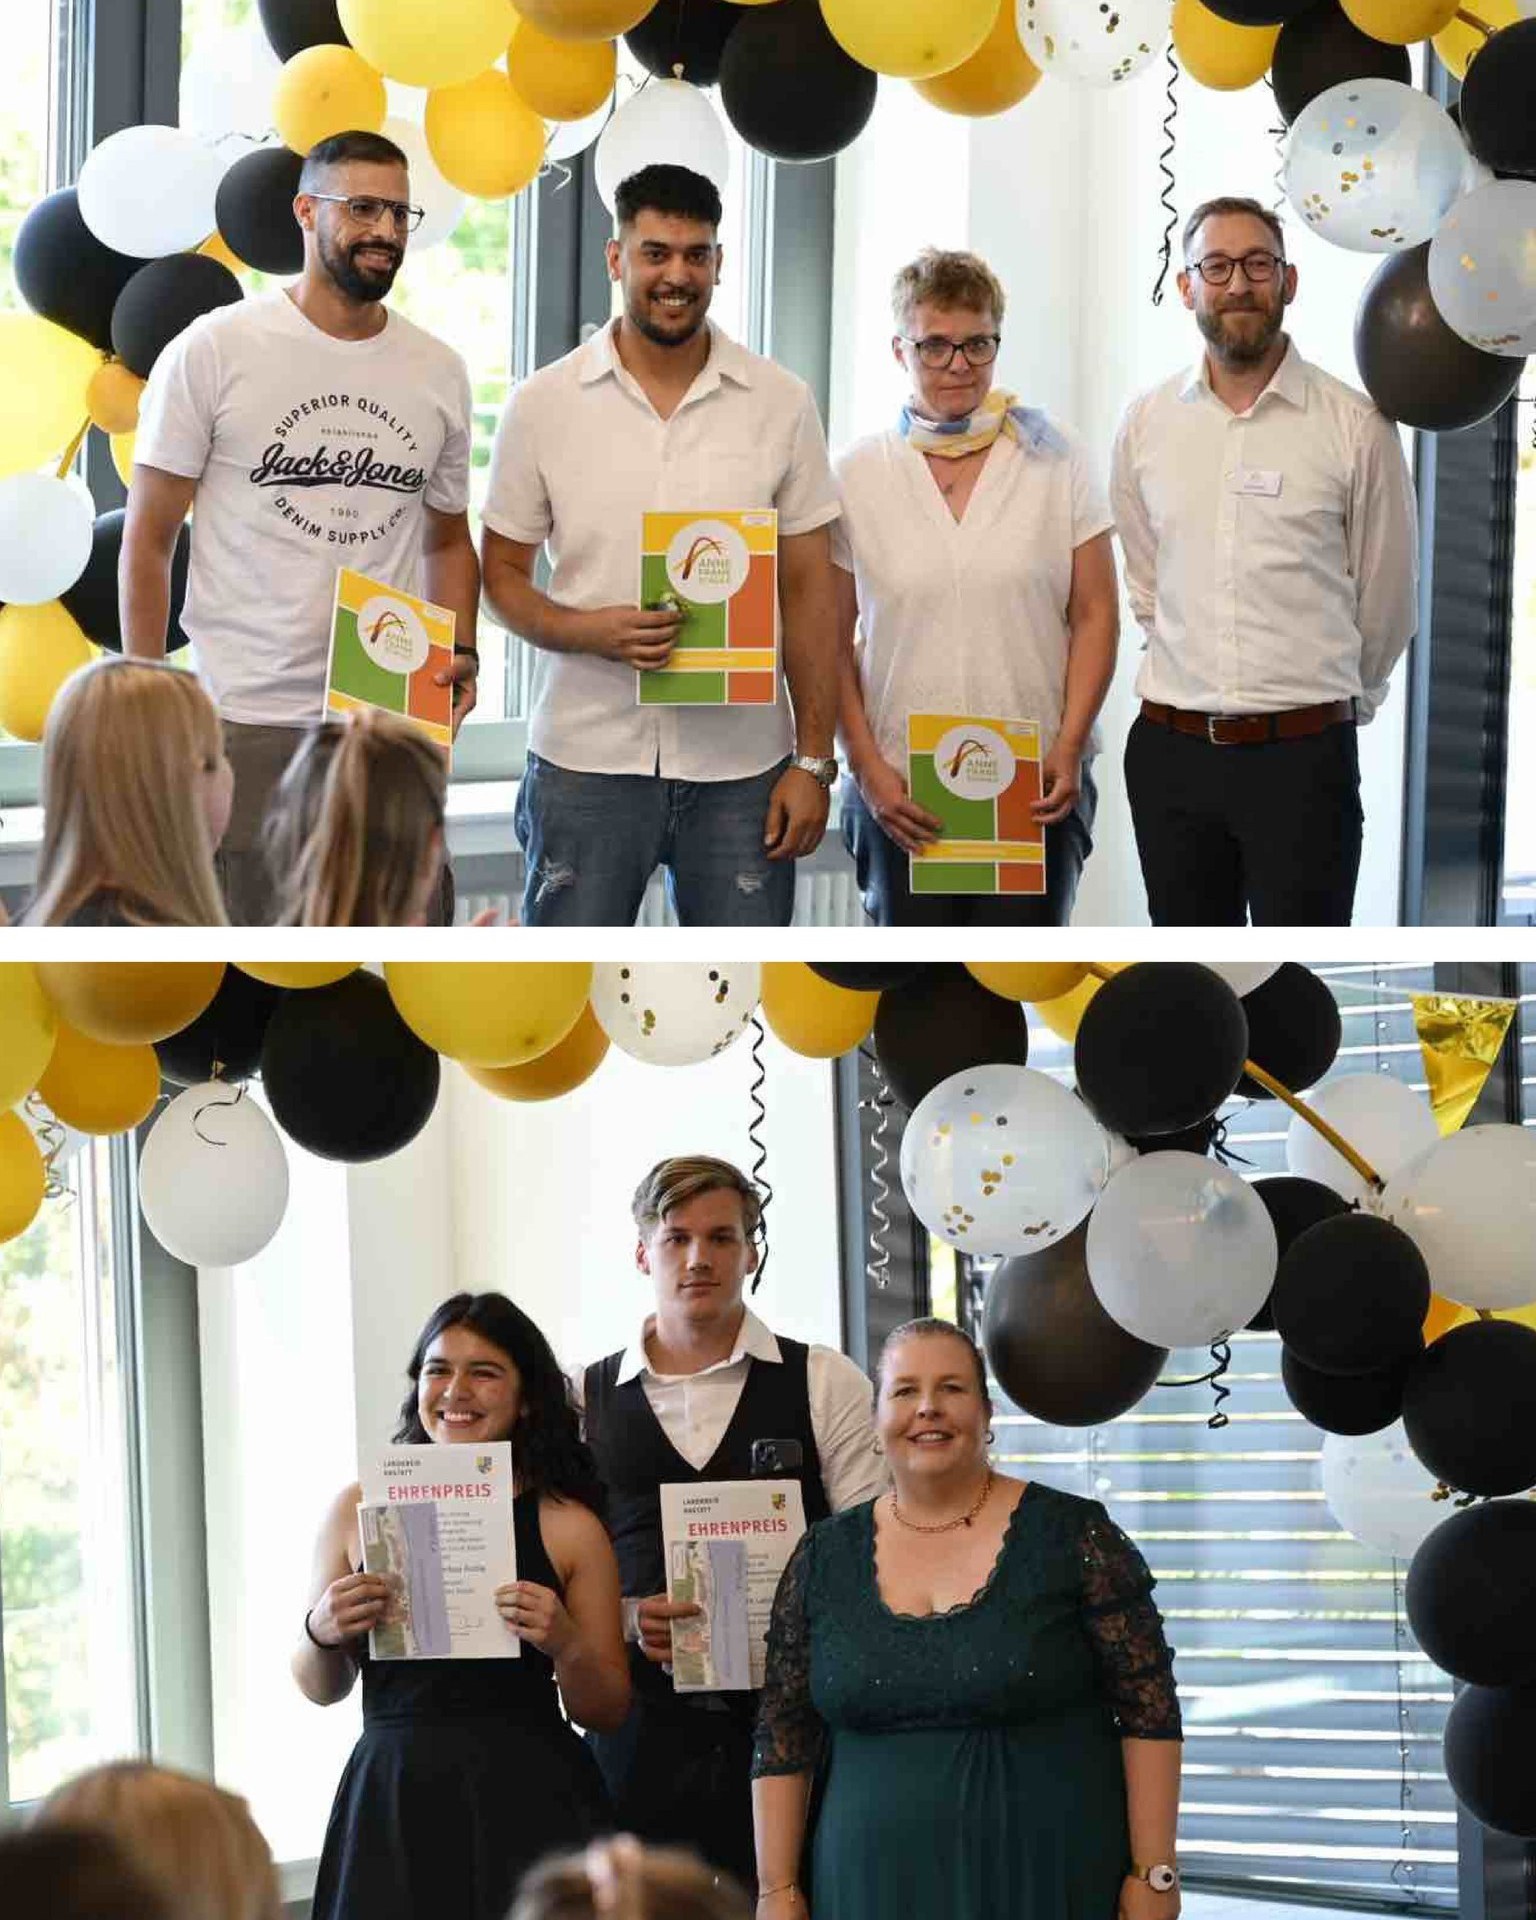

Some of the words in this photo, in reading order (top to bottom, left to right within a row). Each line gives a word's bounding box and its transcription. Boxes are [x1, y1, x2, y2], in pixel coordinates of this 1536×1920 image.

[274, 394, 350, 438] SUPERIOR
[357, 398, 418, 452] QUALITY
[250, 442, 428, 490] Jack&Jones
[274, 496, 322, 537] DENIM
[327, 524, 386, 545] SUPPLY
[387, 1483, 491, 1500] EHRENPREIS
[688, 1519, 787, 1537] EHRENPREIS
